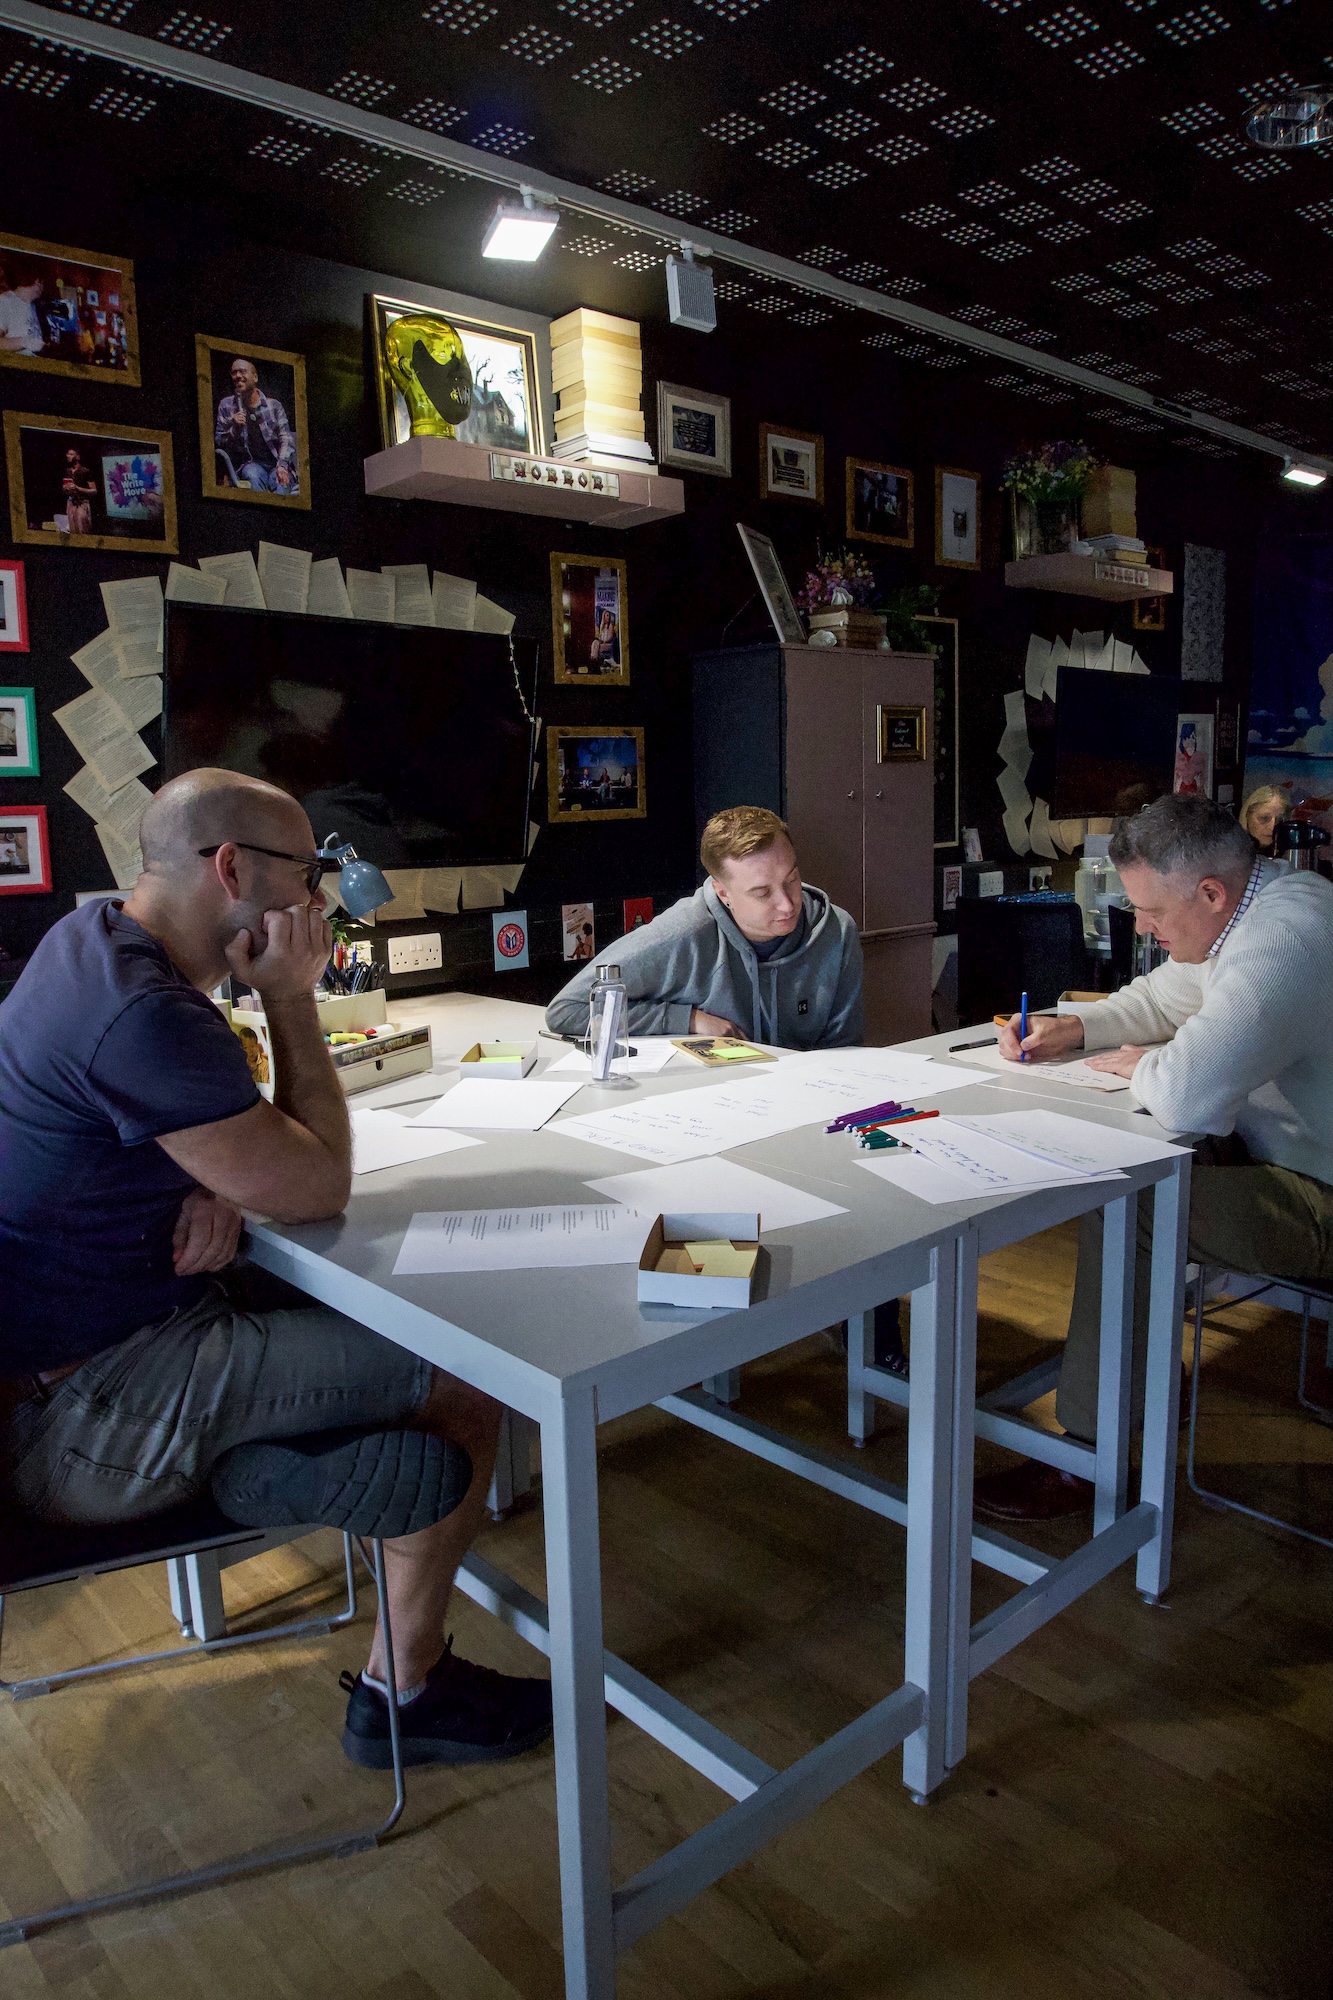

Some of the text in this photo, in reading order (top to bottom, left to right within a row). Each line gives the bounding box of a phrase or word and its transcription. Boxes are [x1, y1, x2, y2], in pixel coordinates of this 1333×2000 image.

[122, 472, 138, 481] The
[514, 460, 604, 491] HORROR
[121, 479, 145, 489] Write
[123, 487, 146, 497] Move
